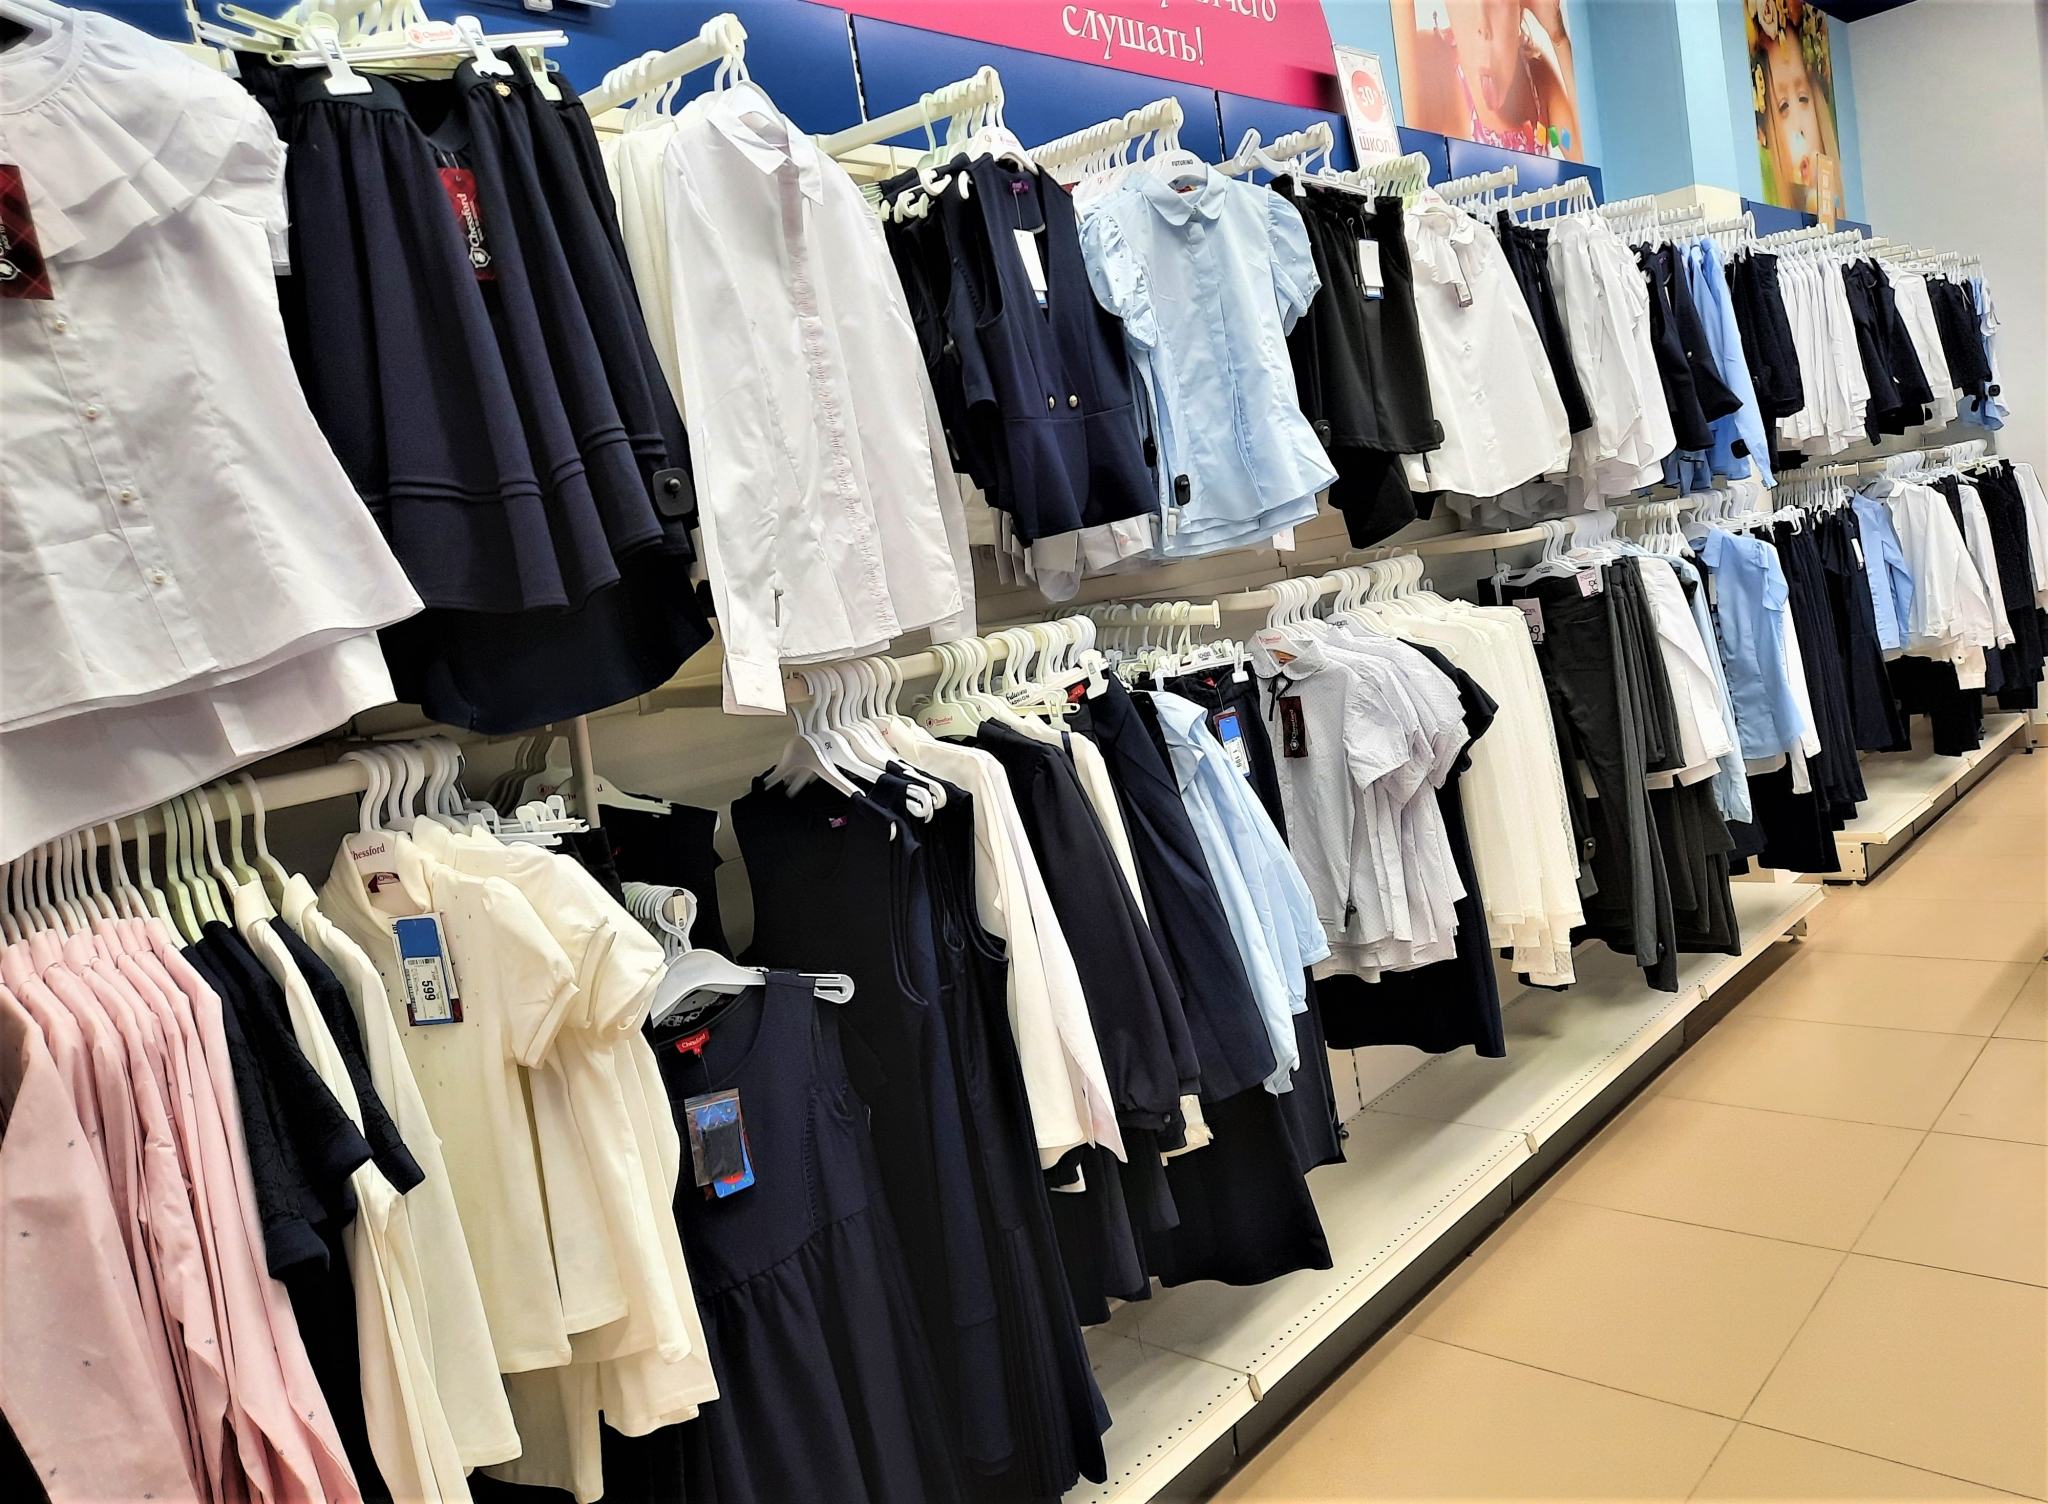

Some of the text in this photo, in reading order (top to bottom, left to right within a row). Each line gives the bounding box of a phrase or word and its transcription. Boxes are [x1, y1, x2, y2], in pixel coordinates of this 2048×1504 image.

[1062, 4, 1205, 66] слушать!
[456, 193, 480, 247] Chessford
[1009, 694, 1030, 706] ASHION
[351, 842, 386, 861] hessford
[421, 980, 436, 1001] 599
